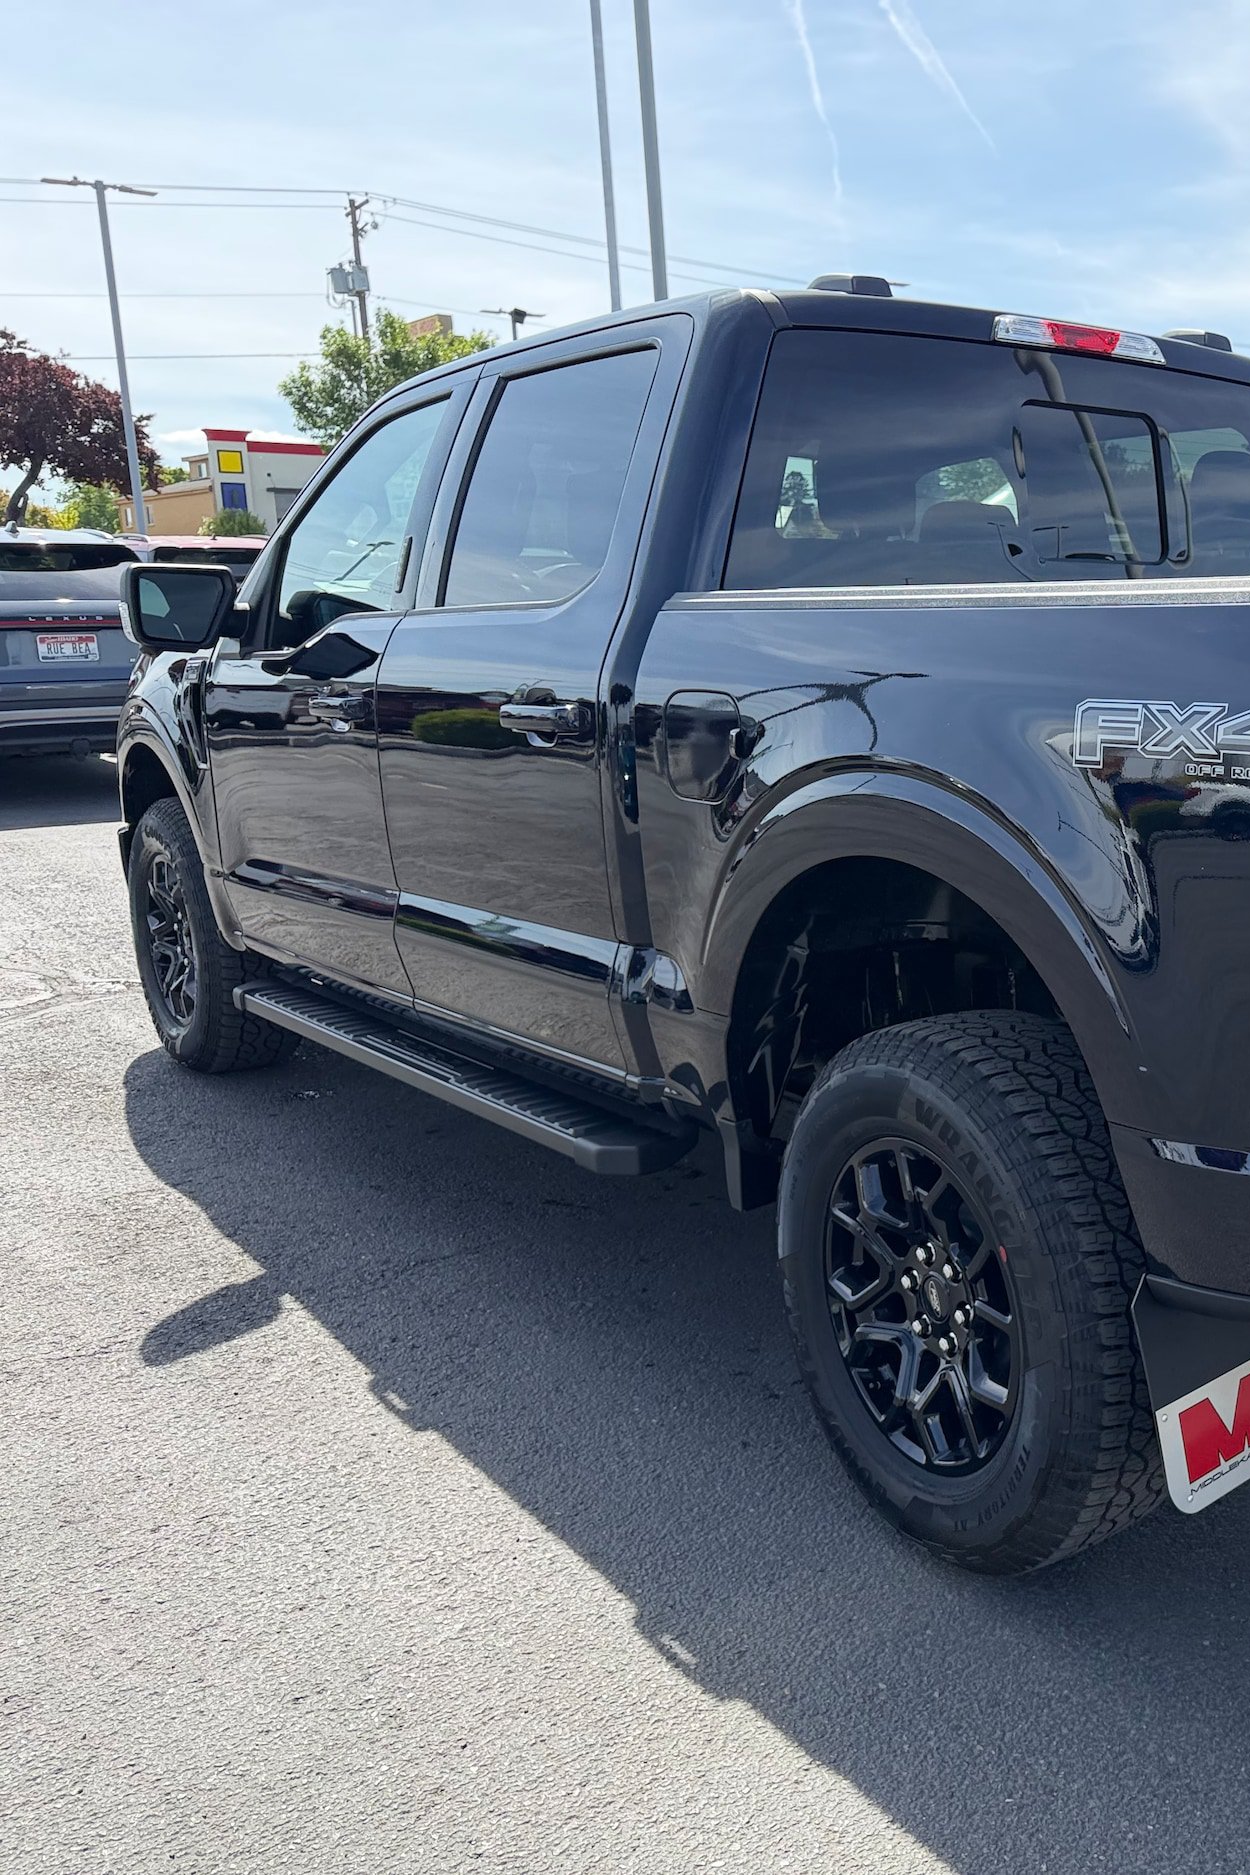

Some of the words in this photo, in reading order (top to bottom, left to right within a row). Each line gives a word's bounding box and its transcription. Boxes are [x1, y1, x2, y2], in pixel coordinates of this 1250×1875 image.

[46, 643, 66, 655] RUE
[72, 642, 91, 654] BEA
[1185, 763, 1225, 777] OFF
